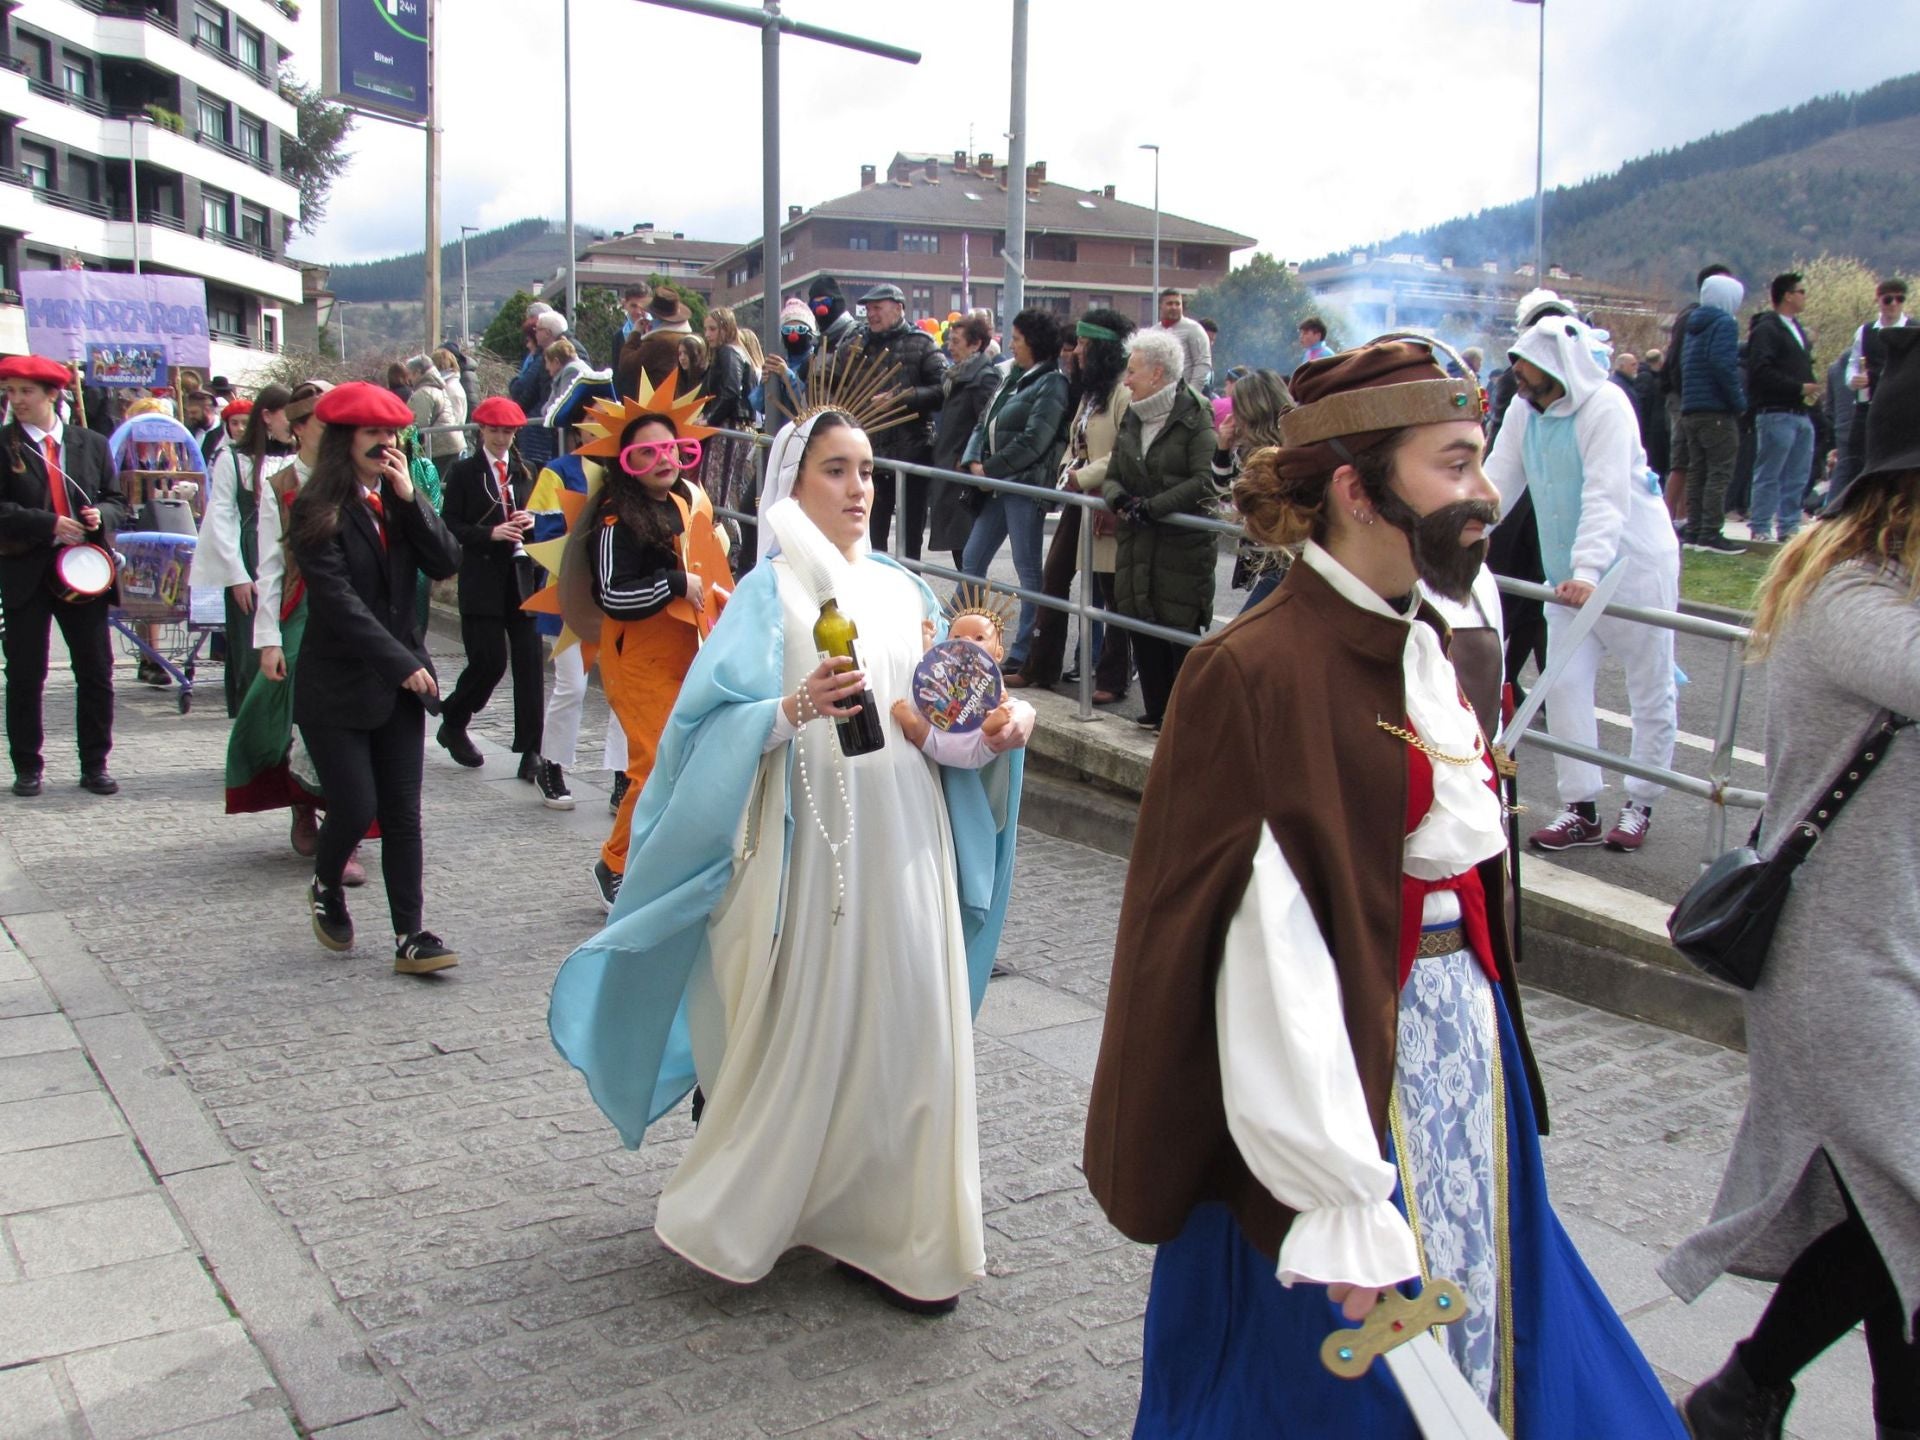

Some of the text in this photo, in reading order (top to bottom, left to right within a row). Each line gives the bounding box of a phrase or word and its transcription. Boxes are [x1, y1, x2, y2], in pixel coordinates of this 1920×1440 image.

[399, 0, 417, 14] 24H
[374, 51, 394, 65] Biteri
[26, 298, 208, 336] MONDRAROA
[956, 674, 994, 725] MONDRAROA
